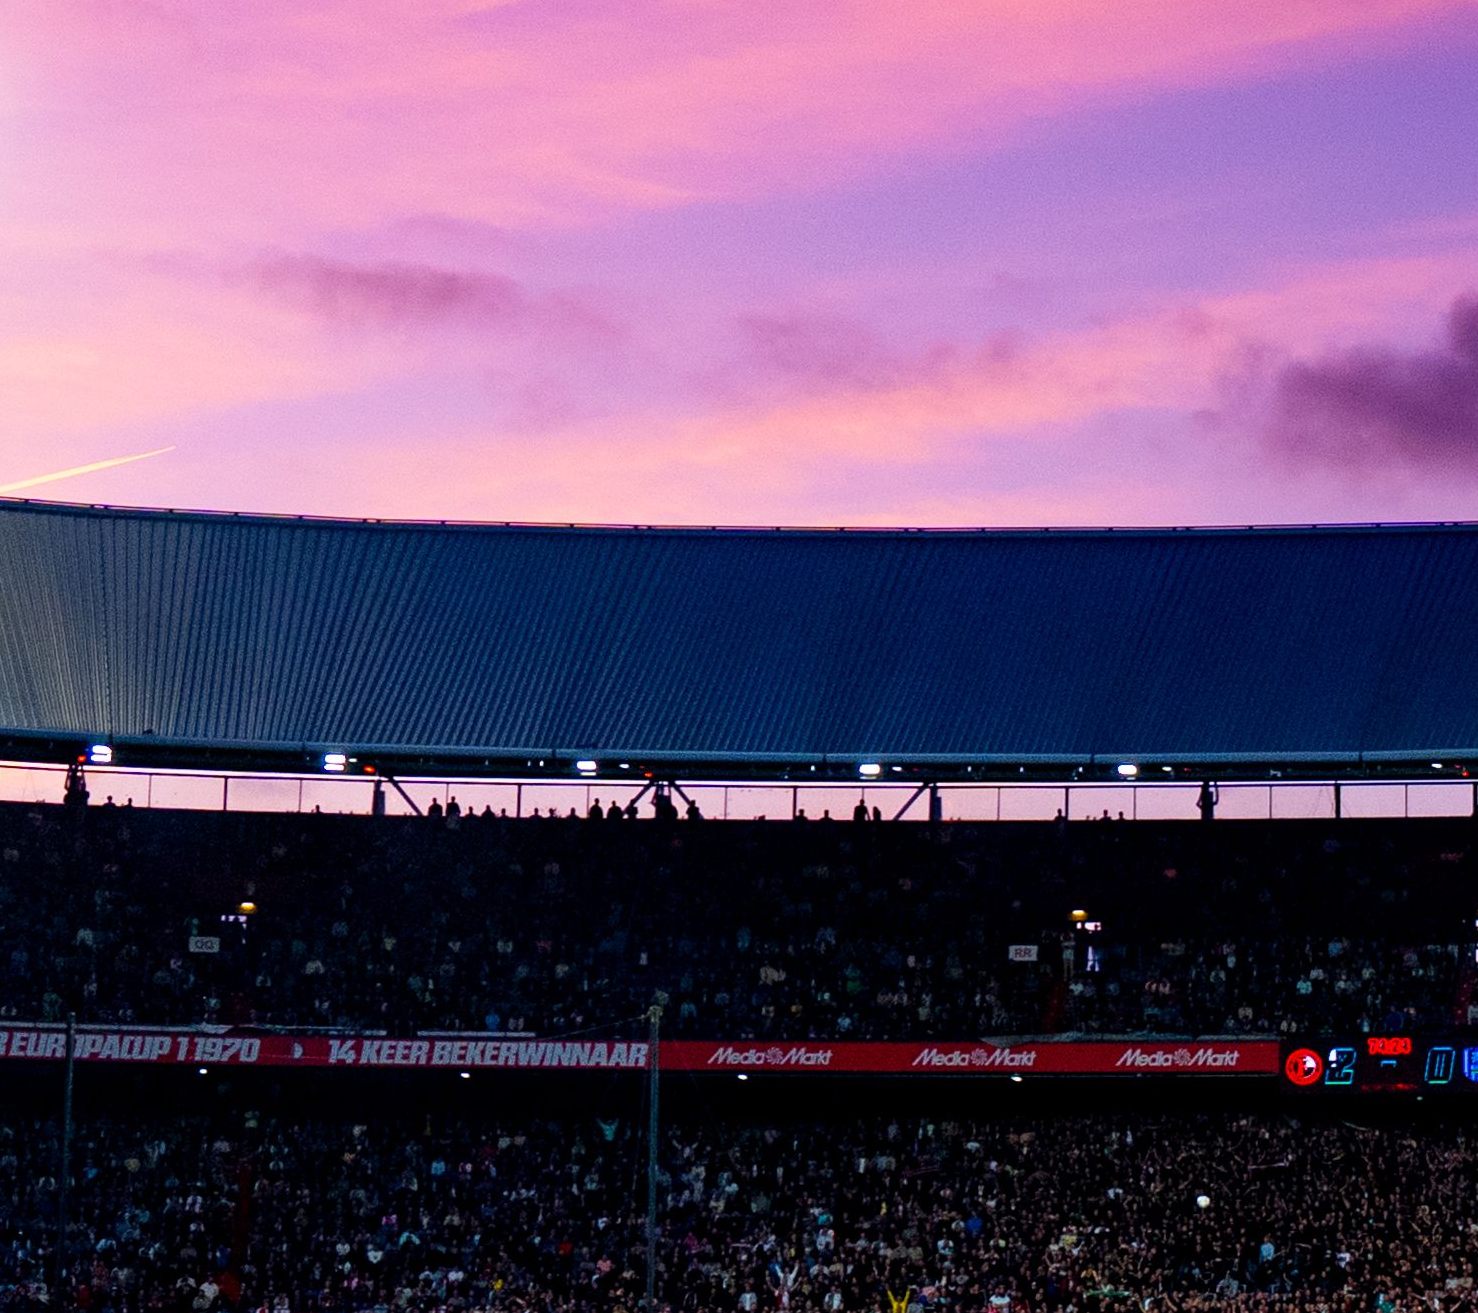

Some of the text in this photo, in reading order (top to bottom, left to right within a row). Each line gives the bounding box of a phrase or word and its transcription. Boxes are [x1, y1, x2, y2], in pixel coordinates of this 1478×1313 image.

[193, 1037, 260, 1063] 1970
[328, 1039, 648, 1067] 14 KEER BEKERWINNAAR
[708, 1047, 833, 1066] Media Markt
[912, 1048, 1037, 1067] Media Markt
[1116, 1049, 1240, 1067] Media Markt
